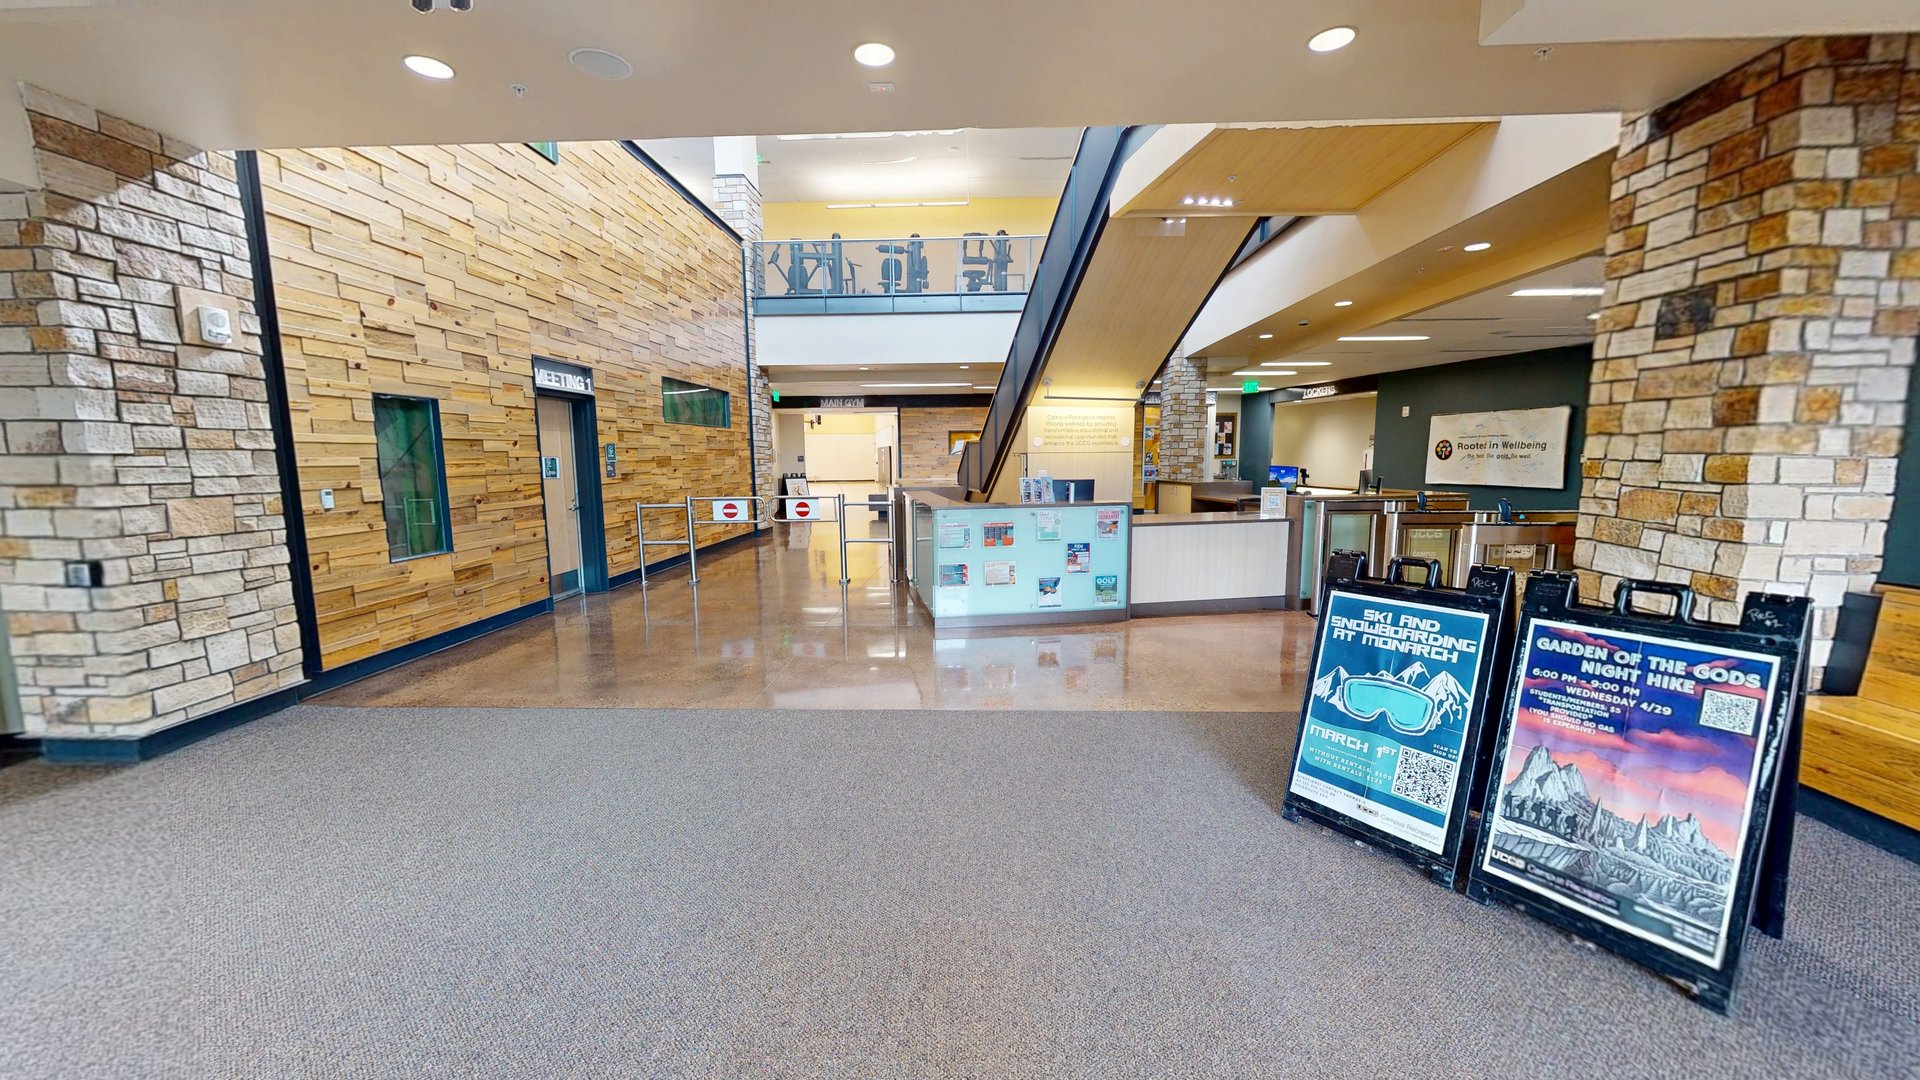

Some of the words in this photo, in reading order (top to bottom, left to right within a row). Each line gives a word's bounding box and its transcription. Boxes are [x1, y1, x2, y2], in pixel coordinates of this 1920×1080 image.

[534, 367, 585, 390] MEETING
[585, 378, 592, 391] 1
[1302, 385, 1336, 399] LOCKERS
[820, 398, 843, 408] MAIN
[844, 398, 865, 408] GYM
[1489, 440, 1499, 449] in
[1502, 440, 1547, 451] Wellbeing
[1331, 615, 1477, 653] SNOWBOARDING
[1363, 609, 1393, 625] SKI
[1399, 614, 1441, 633] AND
[1332, 628, 1356, 642] AT
[1362, 634, 1459, 664] MONARCH
[1536, 637, 1609, 661] GARDEN
[1613, 650, 1643, 667] OF
[1647, 655, 1688, 676] THE
[1692, 663, 1762, 689] GODS
[1580, 660, 1642, 683] NIGHT
[1646, 672, 1696, 695] HIKE
[1532, 668, 1559, 680] 6:00
[1561, 673, 1578, 684] PM
[1590, 680, 1620, 692] 9:00
[1622, 686, 1640, 697] PM
[1529, 688, 1608, 711] STUDENTS/MEMBERS:
[1609, 706, 1622, 714] $5
[1565, 685, 1638, 708] WEDNESDAY
[1639, 701, 1673, 716] 4/29
[1529, 706, 1549, 717] (YOU
[1550, 712, 1582, 725] SHOULD
[1583, 720, 1597, 728] GO
[1597, 723, 1616, 734] GAS
[1543, 716, 1551, 724] IS
[1552, 719, 1597, 735] EXPENSIVE)
[1309, 724, 1369, 754] MARCH
[1375, 745, 1398, 759] 1ST
[1309, 746, 1340, 761] WITHOUT
[1374, 771, 1392, 780] $100
[1314, 756, 1332, 766] WITH
[1366, 775, 1383, 785] $125
[1380, 813, 1405, 829] Campus
[1406, 823, 1440, 842] Recreation
[1491, 848, 1526, 870] UCCS
